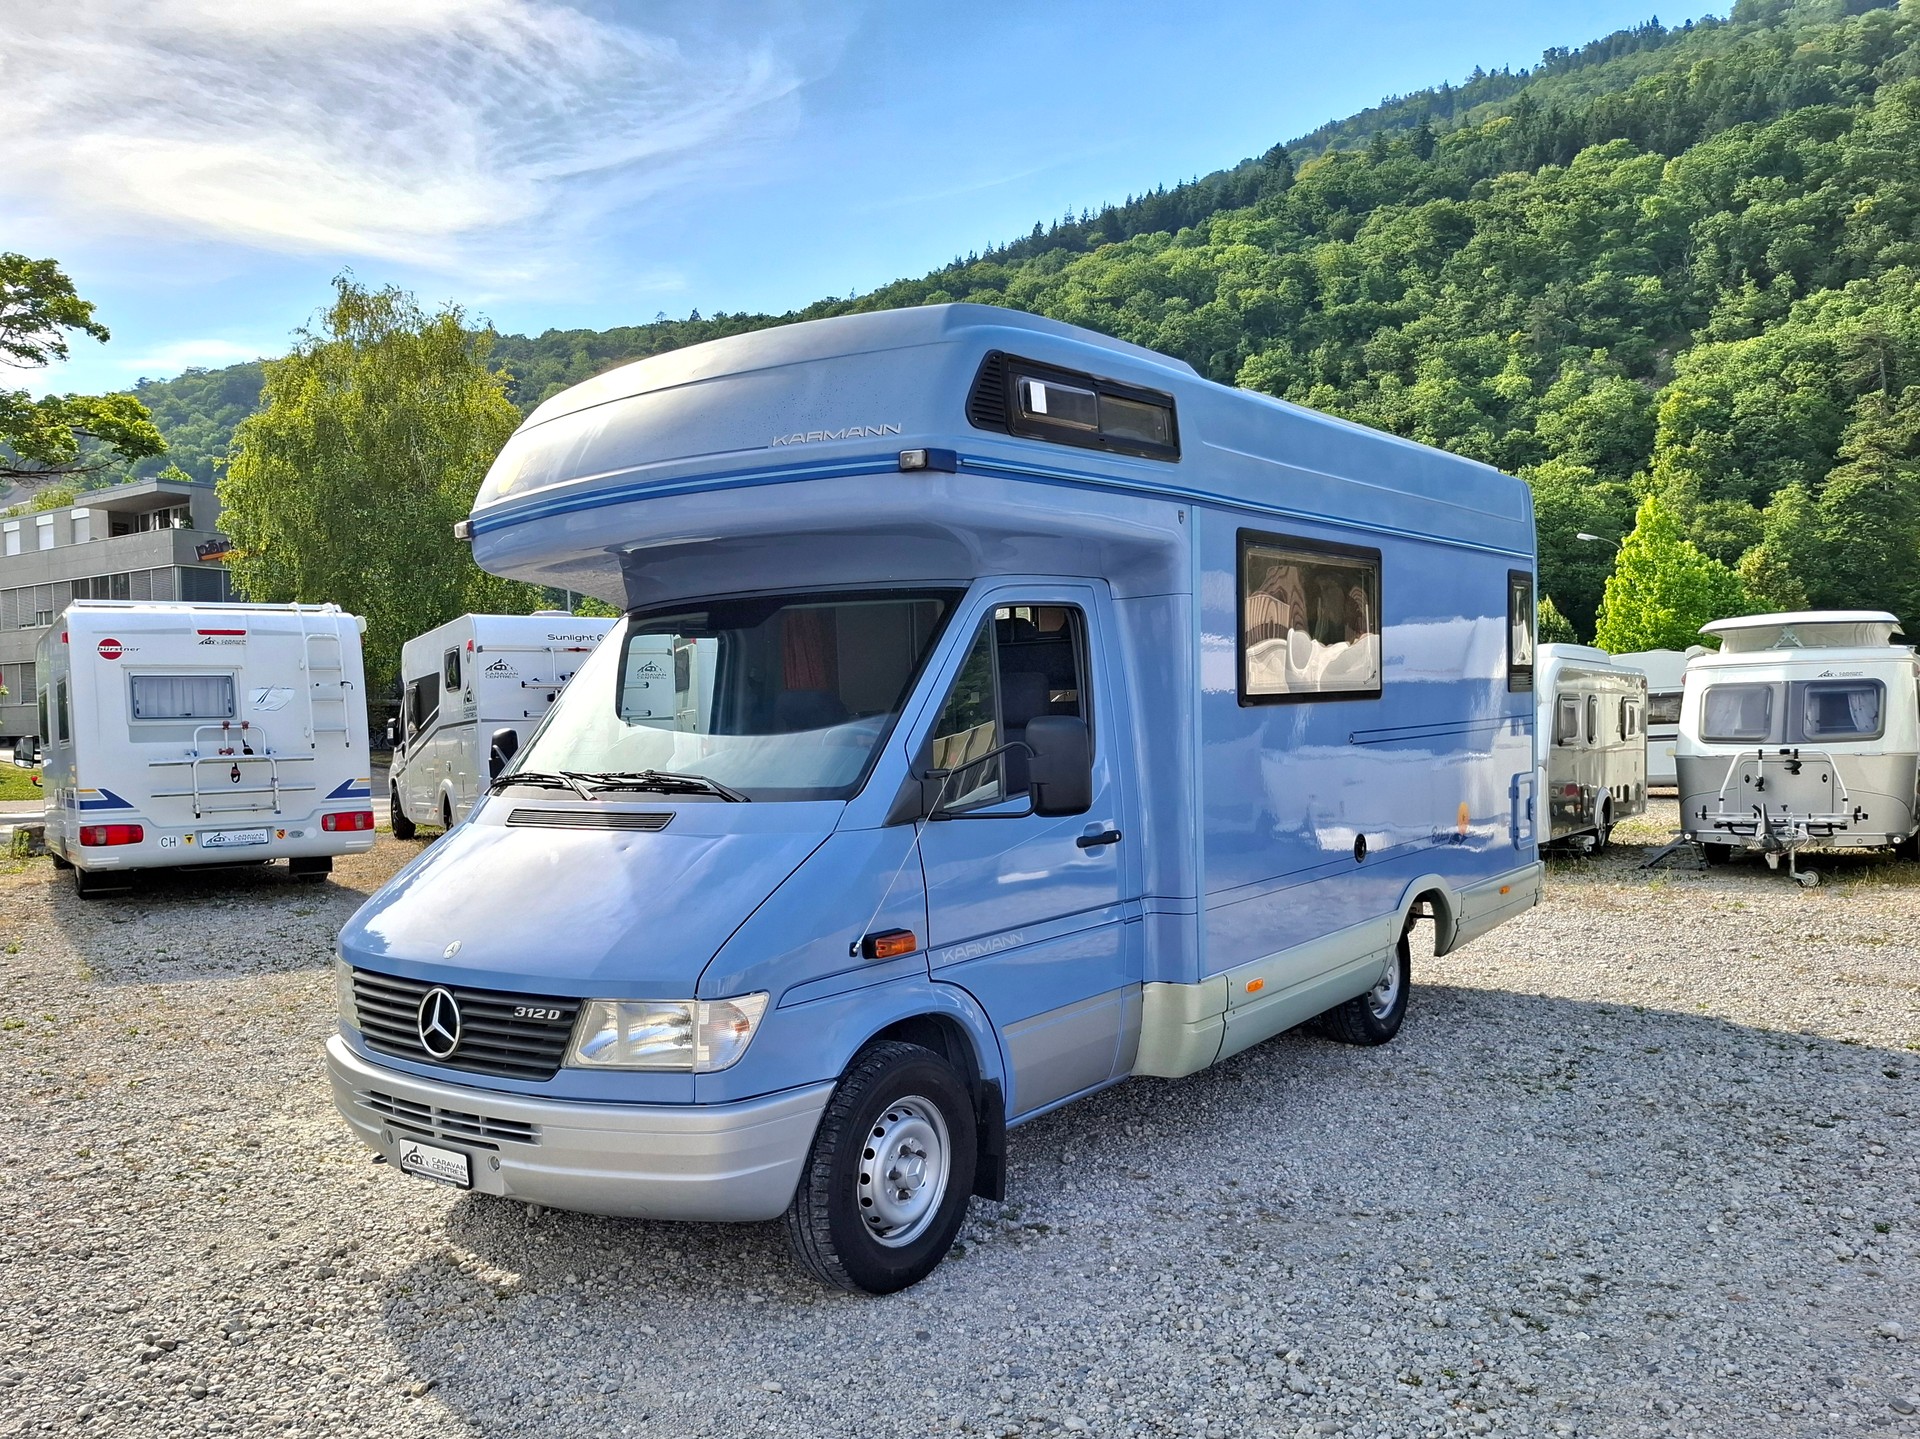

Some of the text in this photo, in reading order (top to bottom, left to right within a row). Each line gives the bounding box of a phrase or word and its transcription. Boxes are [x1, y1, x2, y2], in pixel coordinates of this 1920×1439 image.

[771, 423, 902, 448] KARMANN
[547, 633, 595, 643] Sunlight
[160, 837, 177, 848] CH
[941, 932, 1024, 963] KARMANN
[431, 1157, 466, 1172] CARAVAN
[432, 1163, 458, 1175] CENTRE
